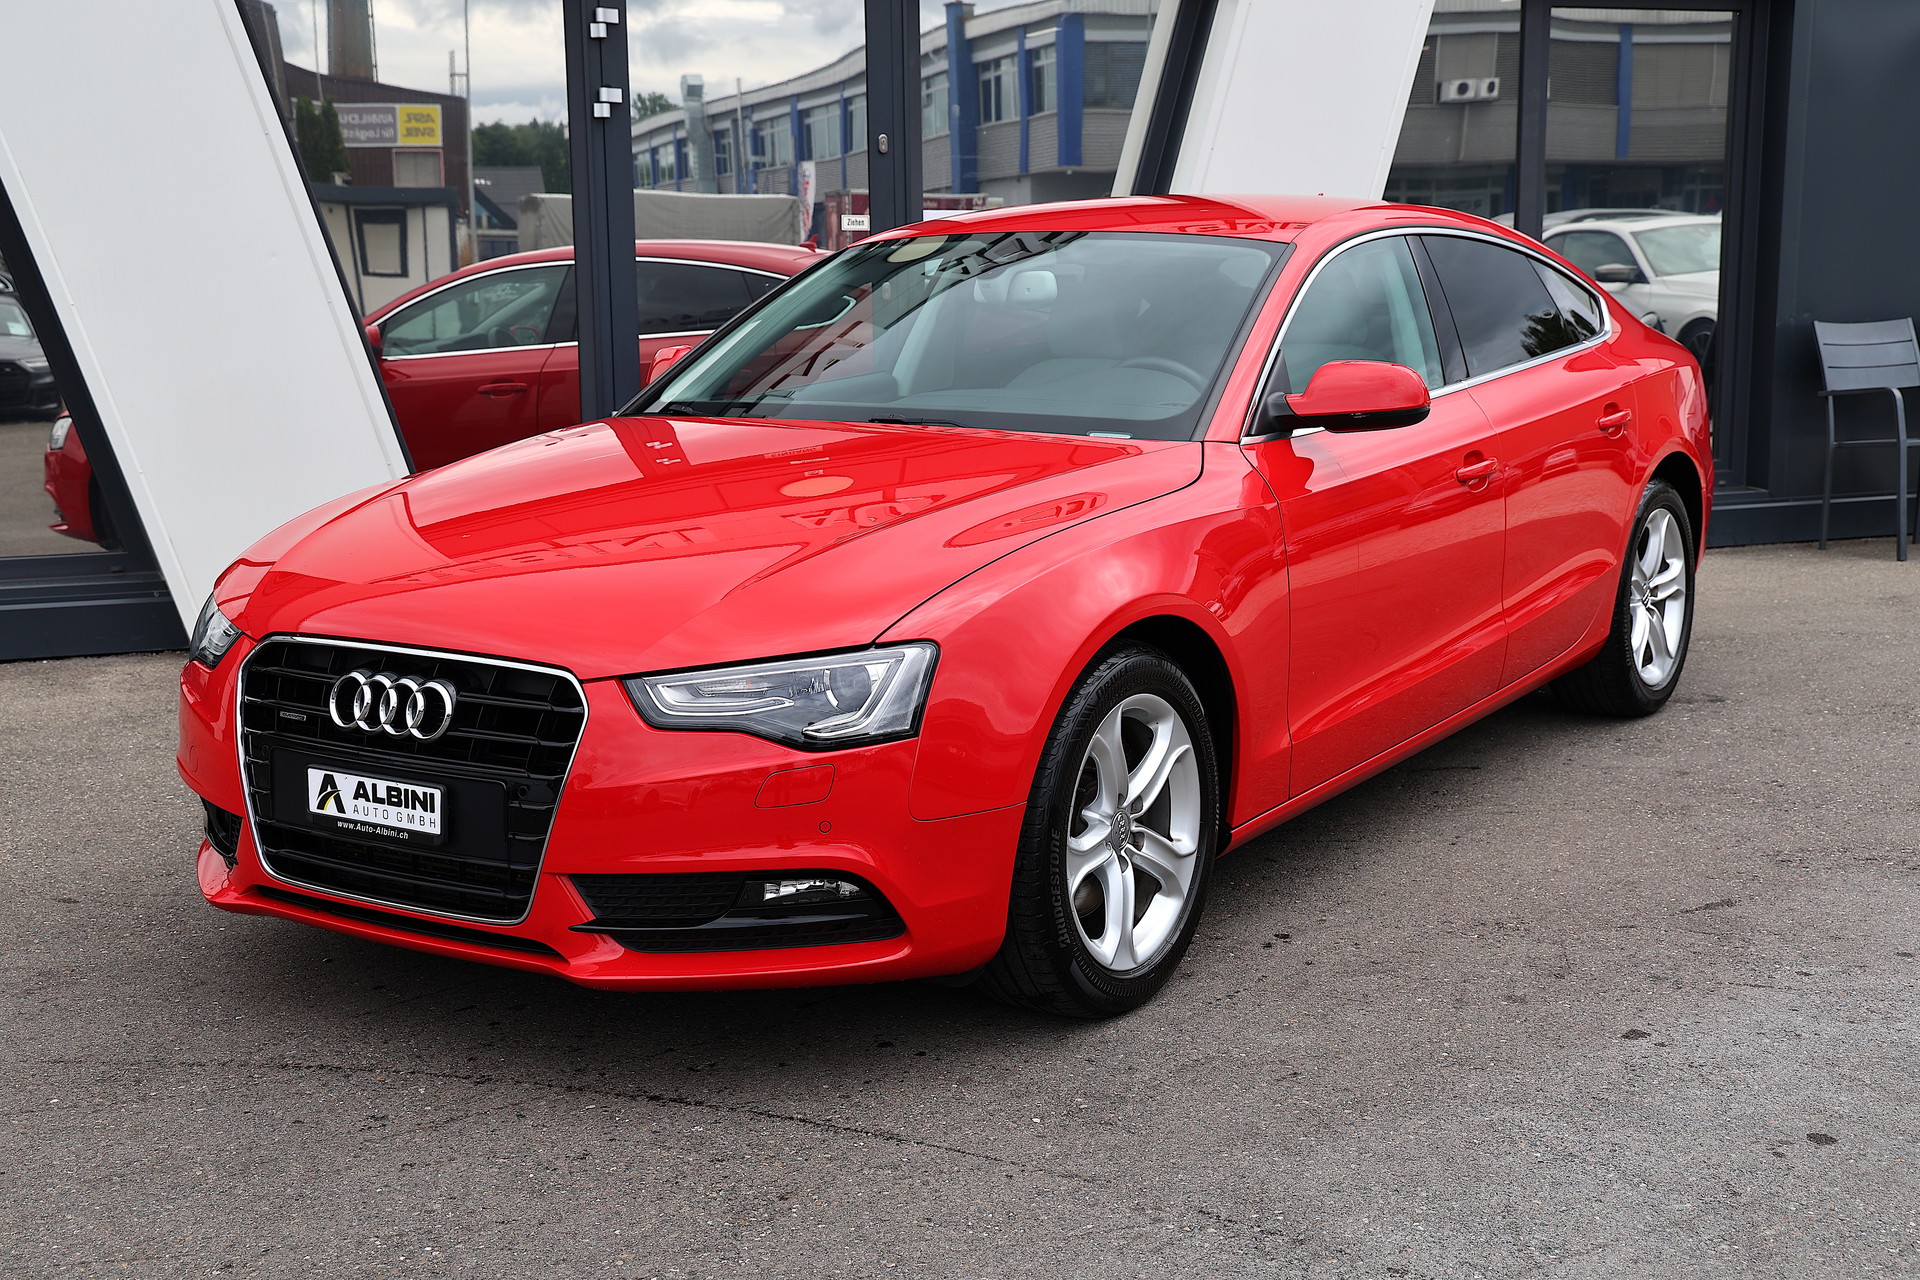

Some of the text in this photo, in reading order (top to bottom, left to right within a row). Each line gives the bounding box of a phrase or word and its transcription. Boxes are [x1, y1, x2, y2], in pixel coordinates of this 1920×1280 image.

[847, 218, 865, 226] Ziehen
[353, 780, 436, 814] ALBINI
[353, 804, 436, 829] AUTO GMBH
[337, 820, 409, 840] www.Auto-Albini.ch
[1051, 828, 1070, 948] BRIDGESTONE
